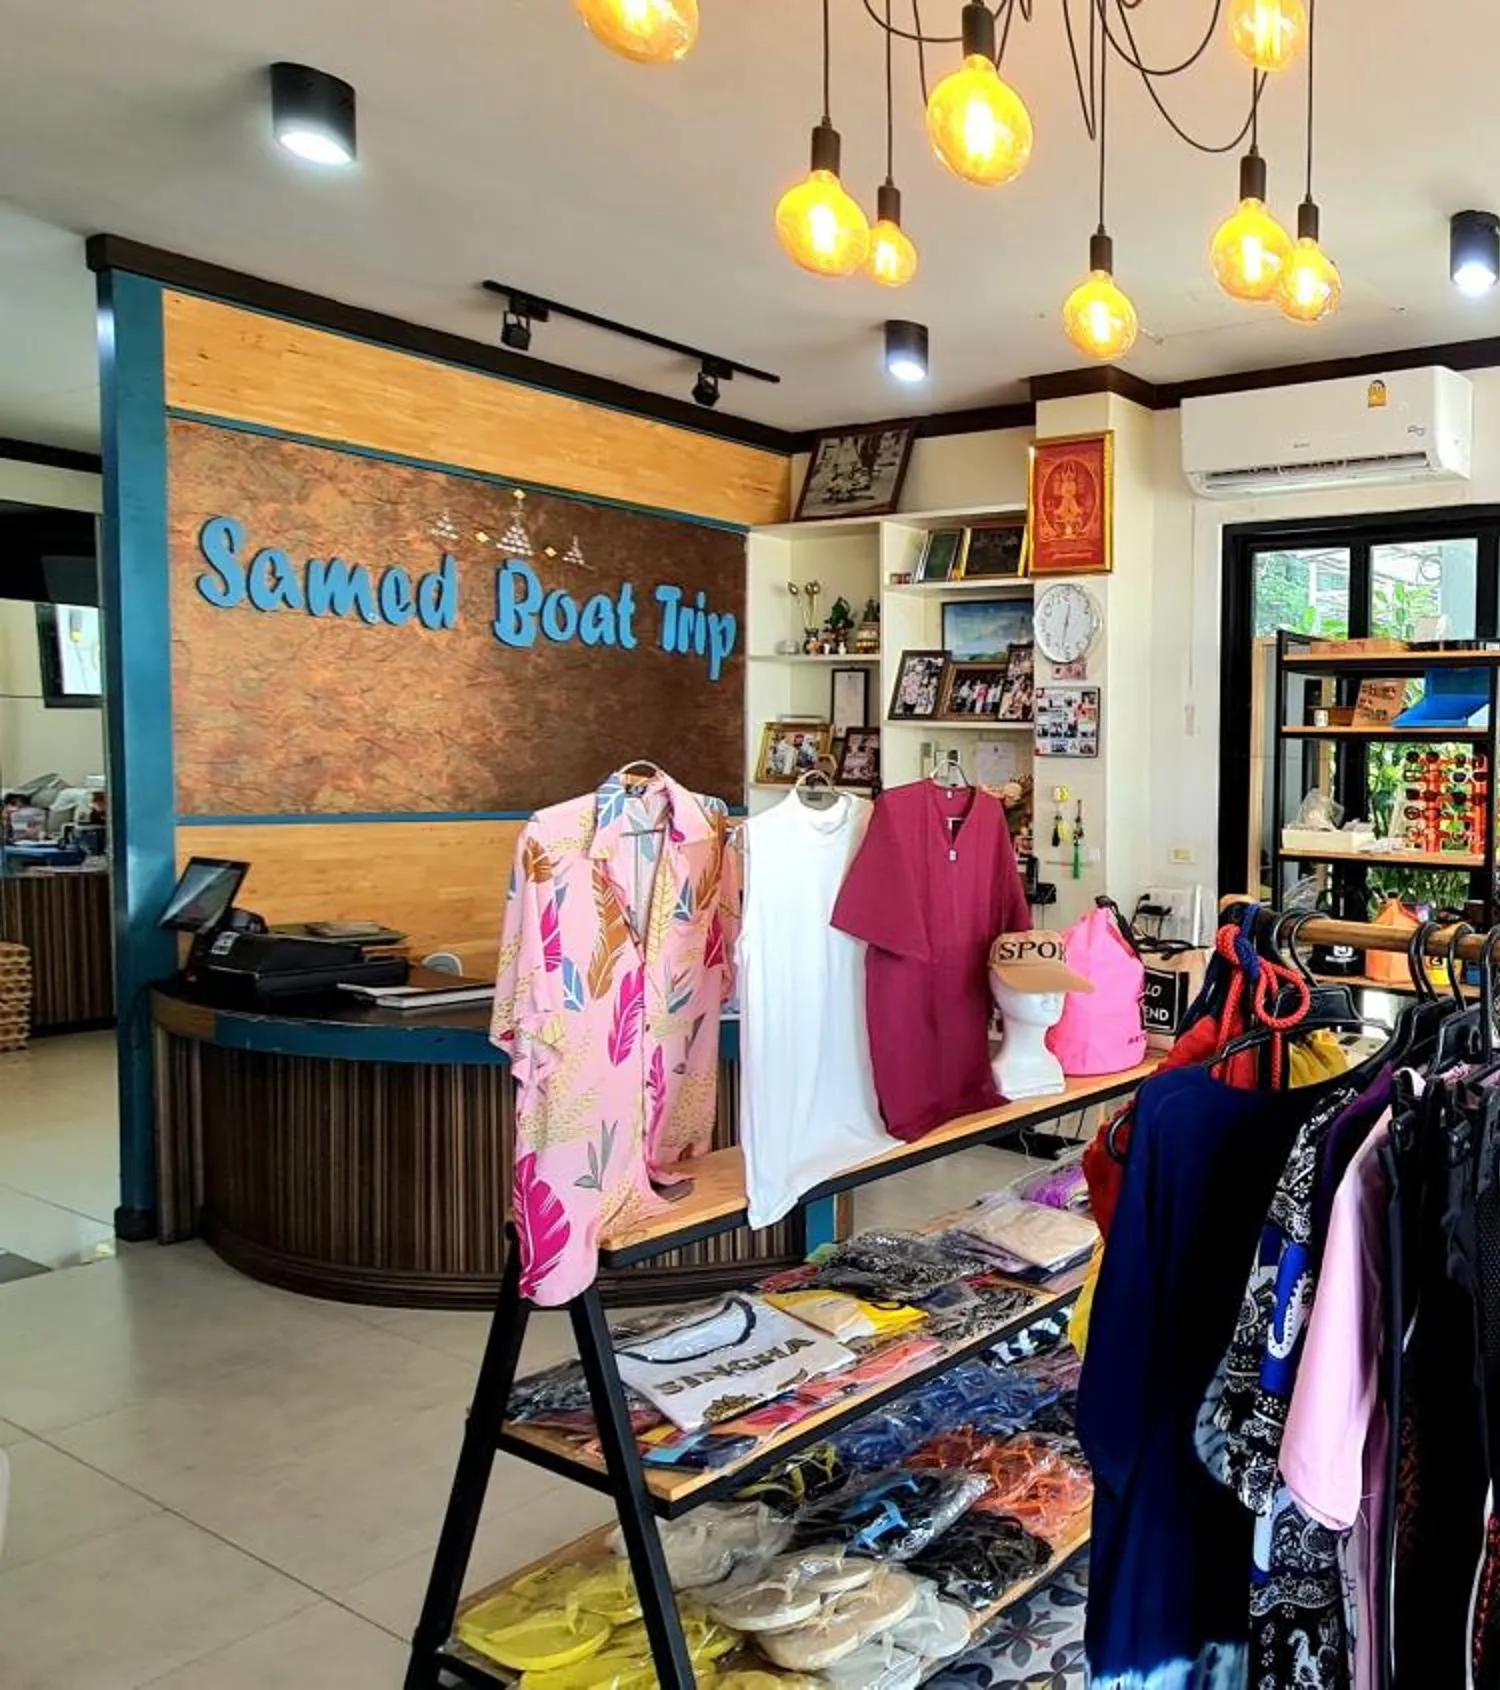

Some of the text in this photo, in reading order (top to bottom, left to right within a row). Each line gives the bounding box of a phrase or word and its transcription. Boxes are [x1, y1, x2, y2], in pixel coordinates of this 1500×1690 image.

[196, 514, 738, 683] Samed Boat Trip
[652, 1336, 816, 1395] SINGHA
